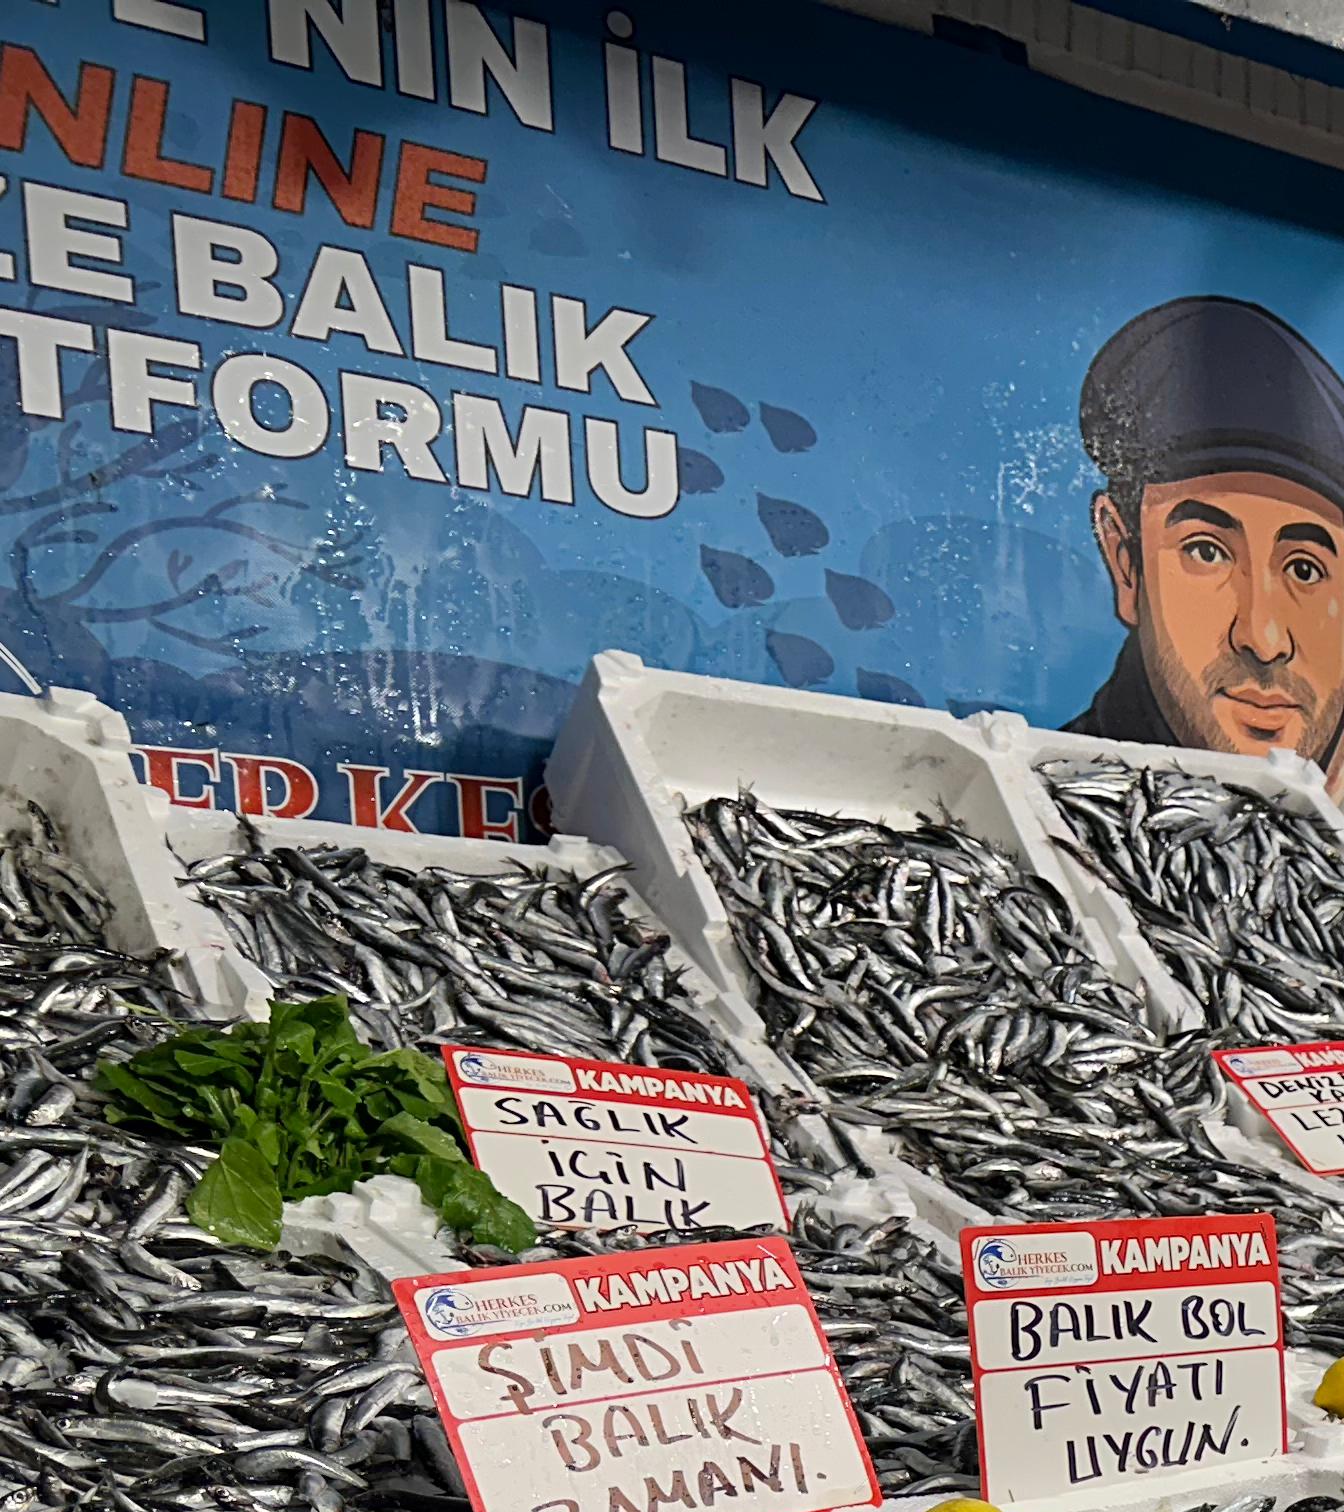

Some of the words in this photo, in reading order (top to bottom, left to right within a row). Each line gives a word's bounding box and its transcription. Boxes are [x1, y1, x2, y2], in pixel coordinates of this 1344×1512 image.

[604, 10, 826, 203] İLK
[171, 209, 660, 408] BALIK
[575, 1067, 747, 1109] KAMPANYA
[534, 1183, 711, 1229] BALIK
[573, 1256, 796, 1313] KAMPANYA
[1018, 1252, 1068, 1266] HERKES
[1100, 1232, 1271, 1276] KAMPANYA
[475, 1293, 538, 1312] HERKES
[1011, 1300, 1158, 1361] BALIK
[1181, 1295, 1266, 1339] BOL
[477, 1319, 704, 1415] ŞİMDİ
[1024, 1359, 1223, 1429] FİYATI
[542, 1387, 763, 1472] BALIK
